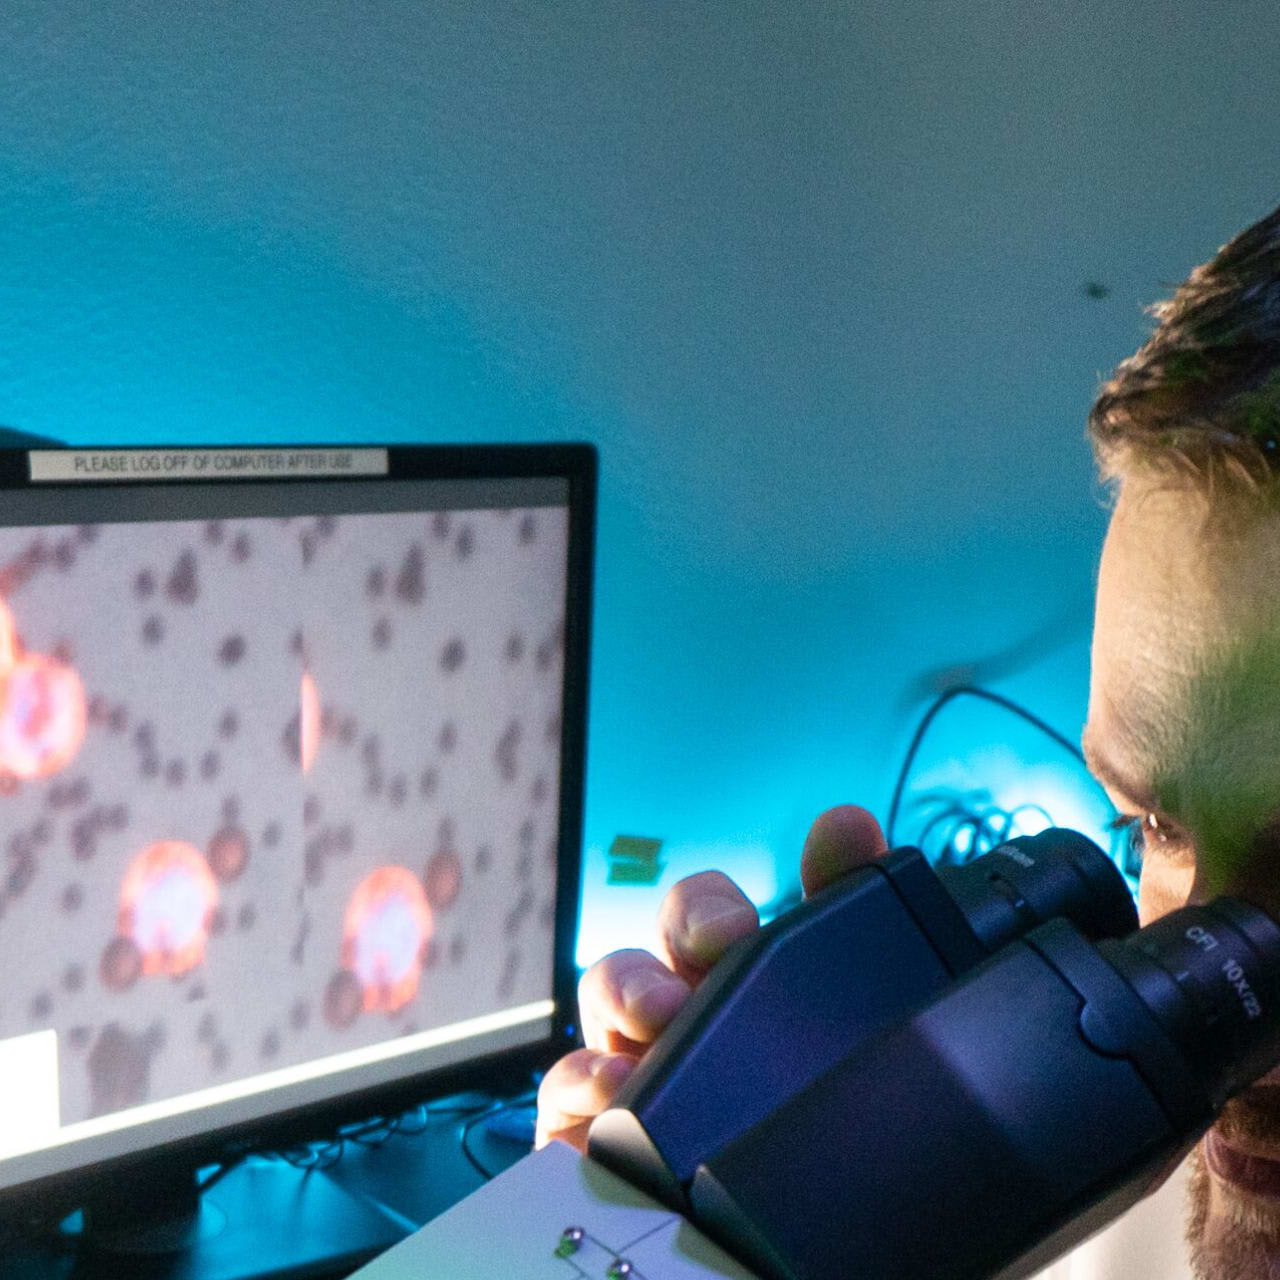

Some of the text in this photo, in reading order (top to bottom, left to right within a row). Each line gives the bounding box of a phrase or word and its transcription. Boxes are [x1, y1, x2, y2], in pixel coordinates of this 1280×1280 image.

[74, 453, 352, 472] PLEASE LOG OFF OF COMPUTER AFTER USE
[1186, 925, 1219, 951] CFI
